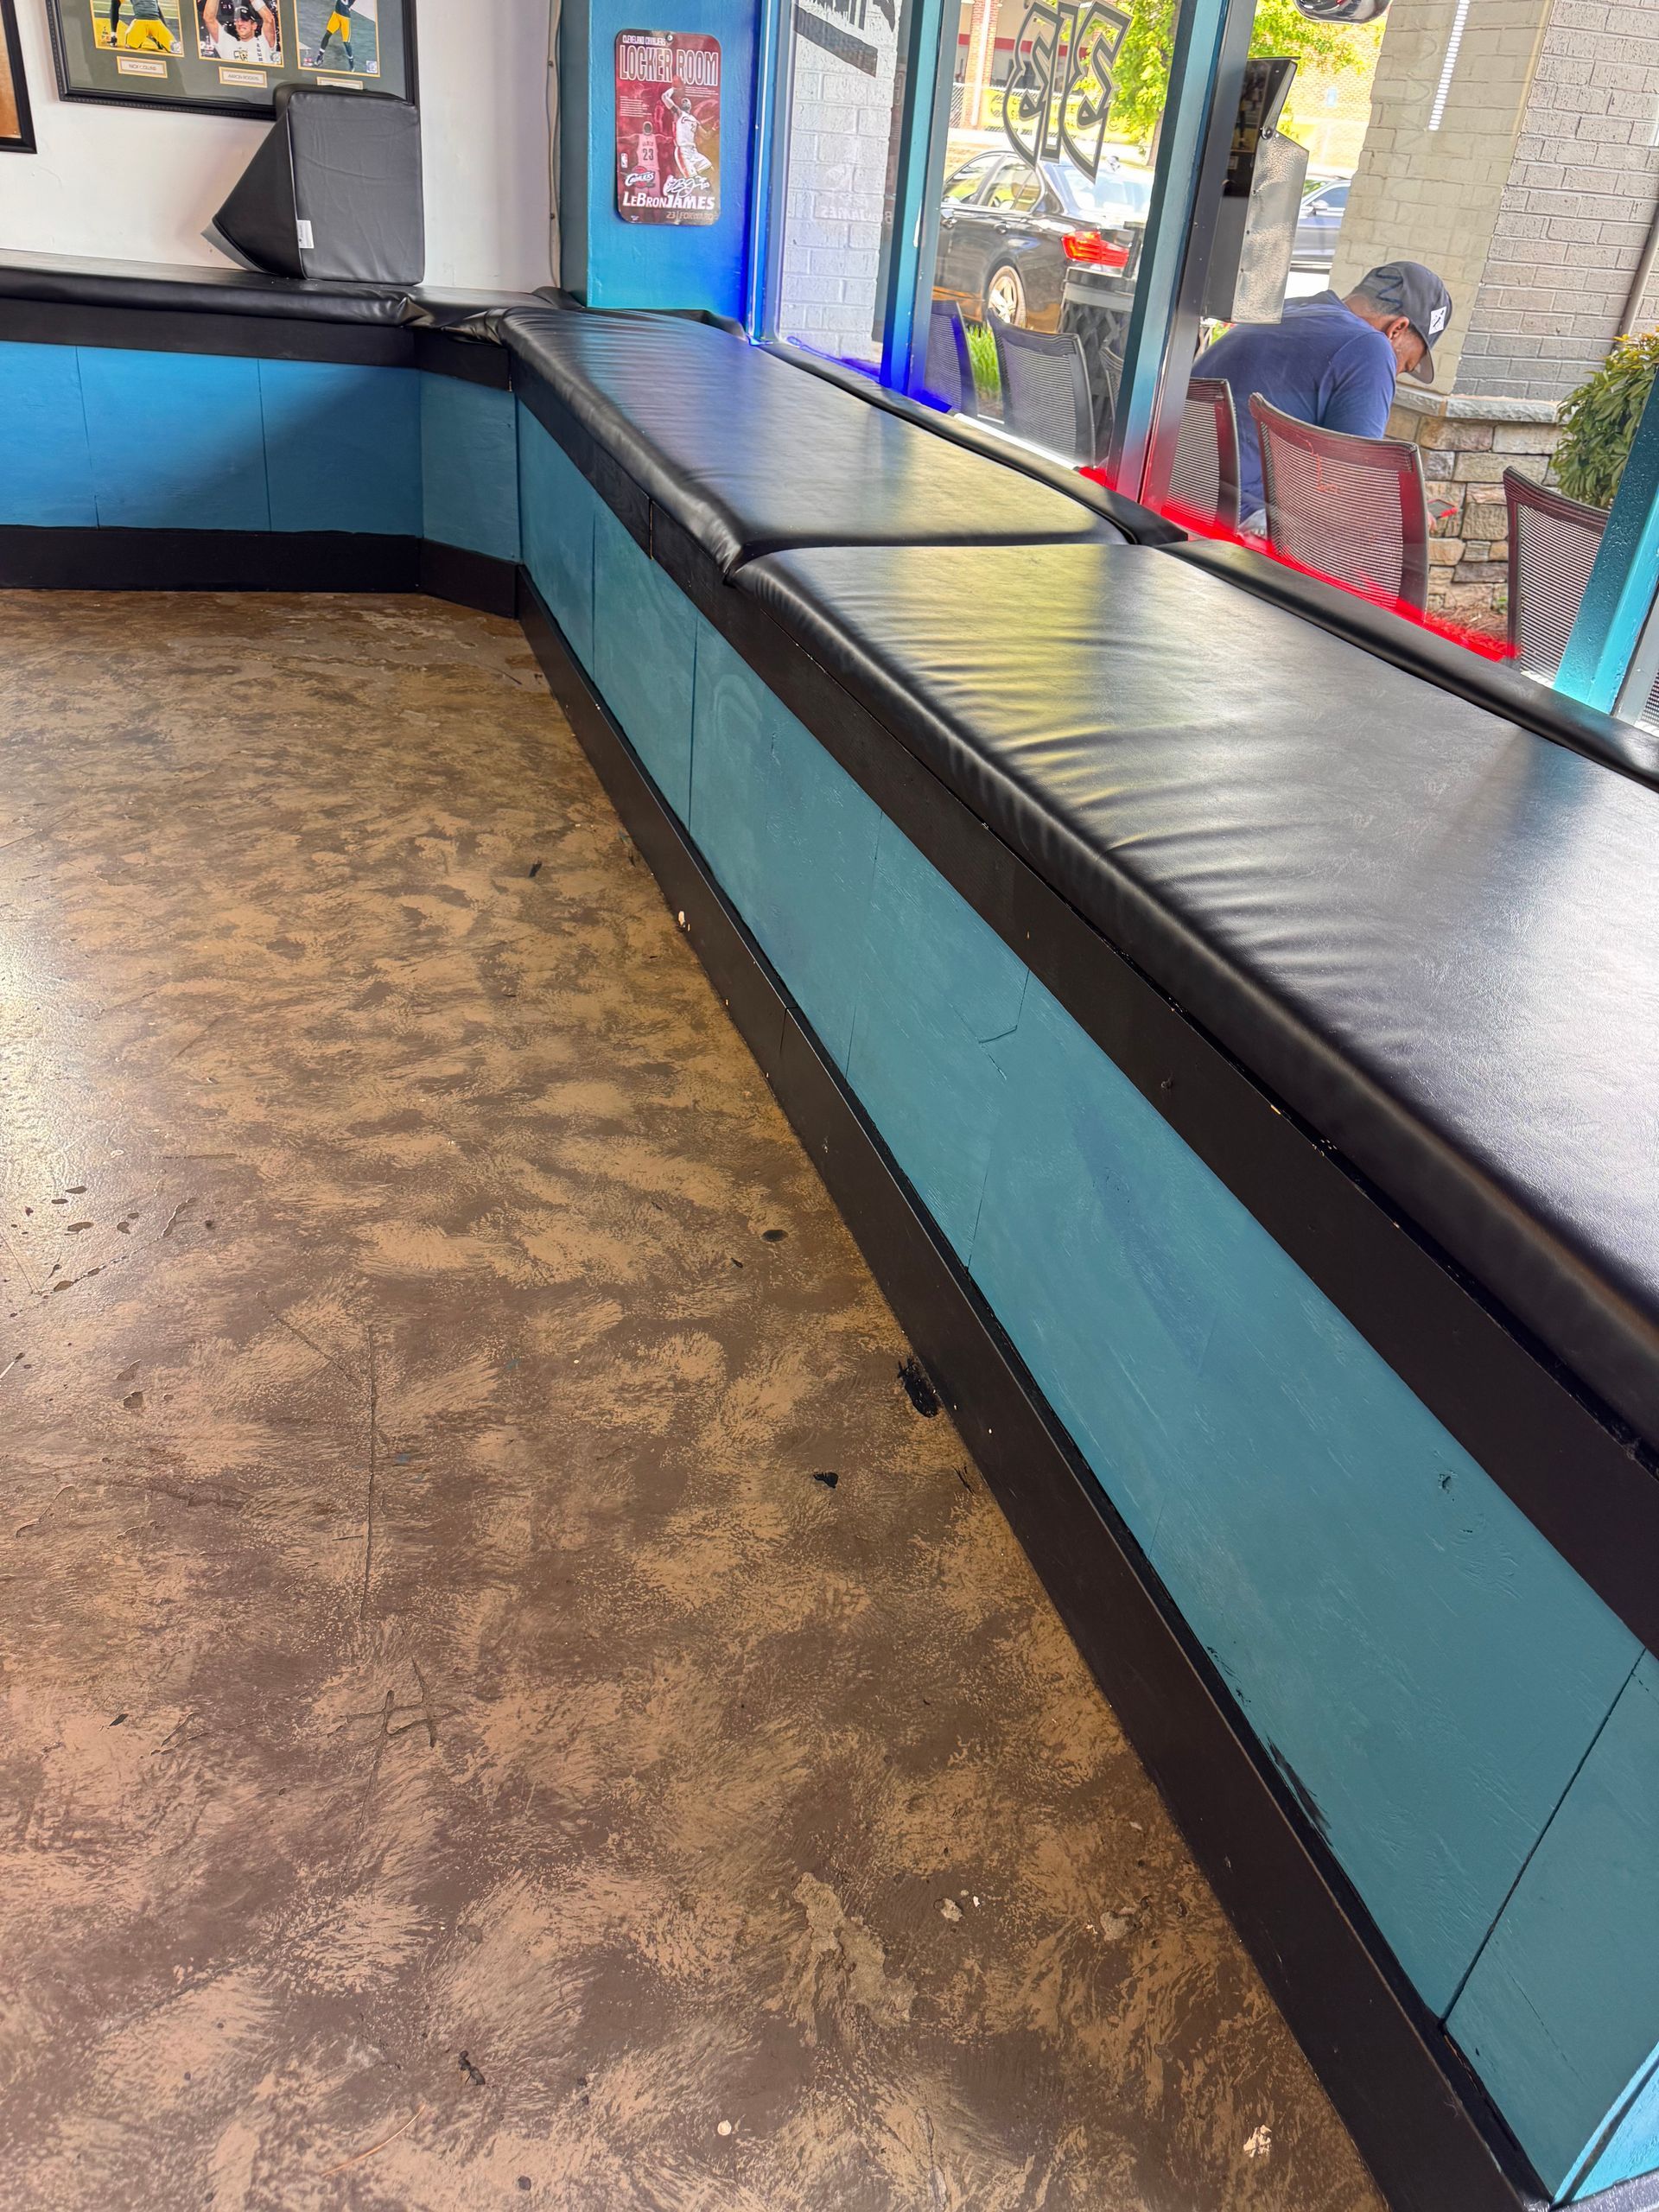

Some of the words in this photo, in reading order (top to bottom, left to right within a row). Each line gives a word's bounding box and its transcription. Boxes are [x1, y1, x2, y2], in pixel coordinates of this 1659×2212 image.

[620, 45, 673, 83] LOCKER
[676, 49, 719, 86] ROOM
[642, 148, 654, 161] 23
